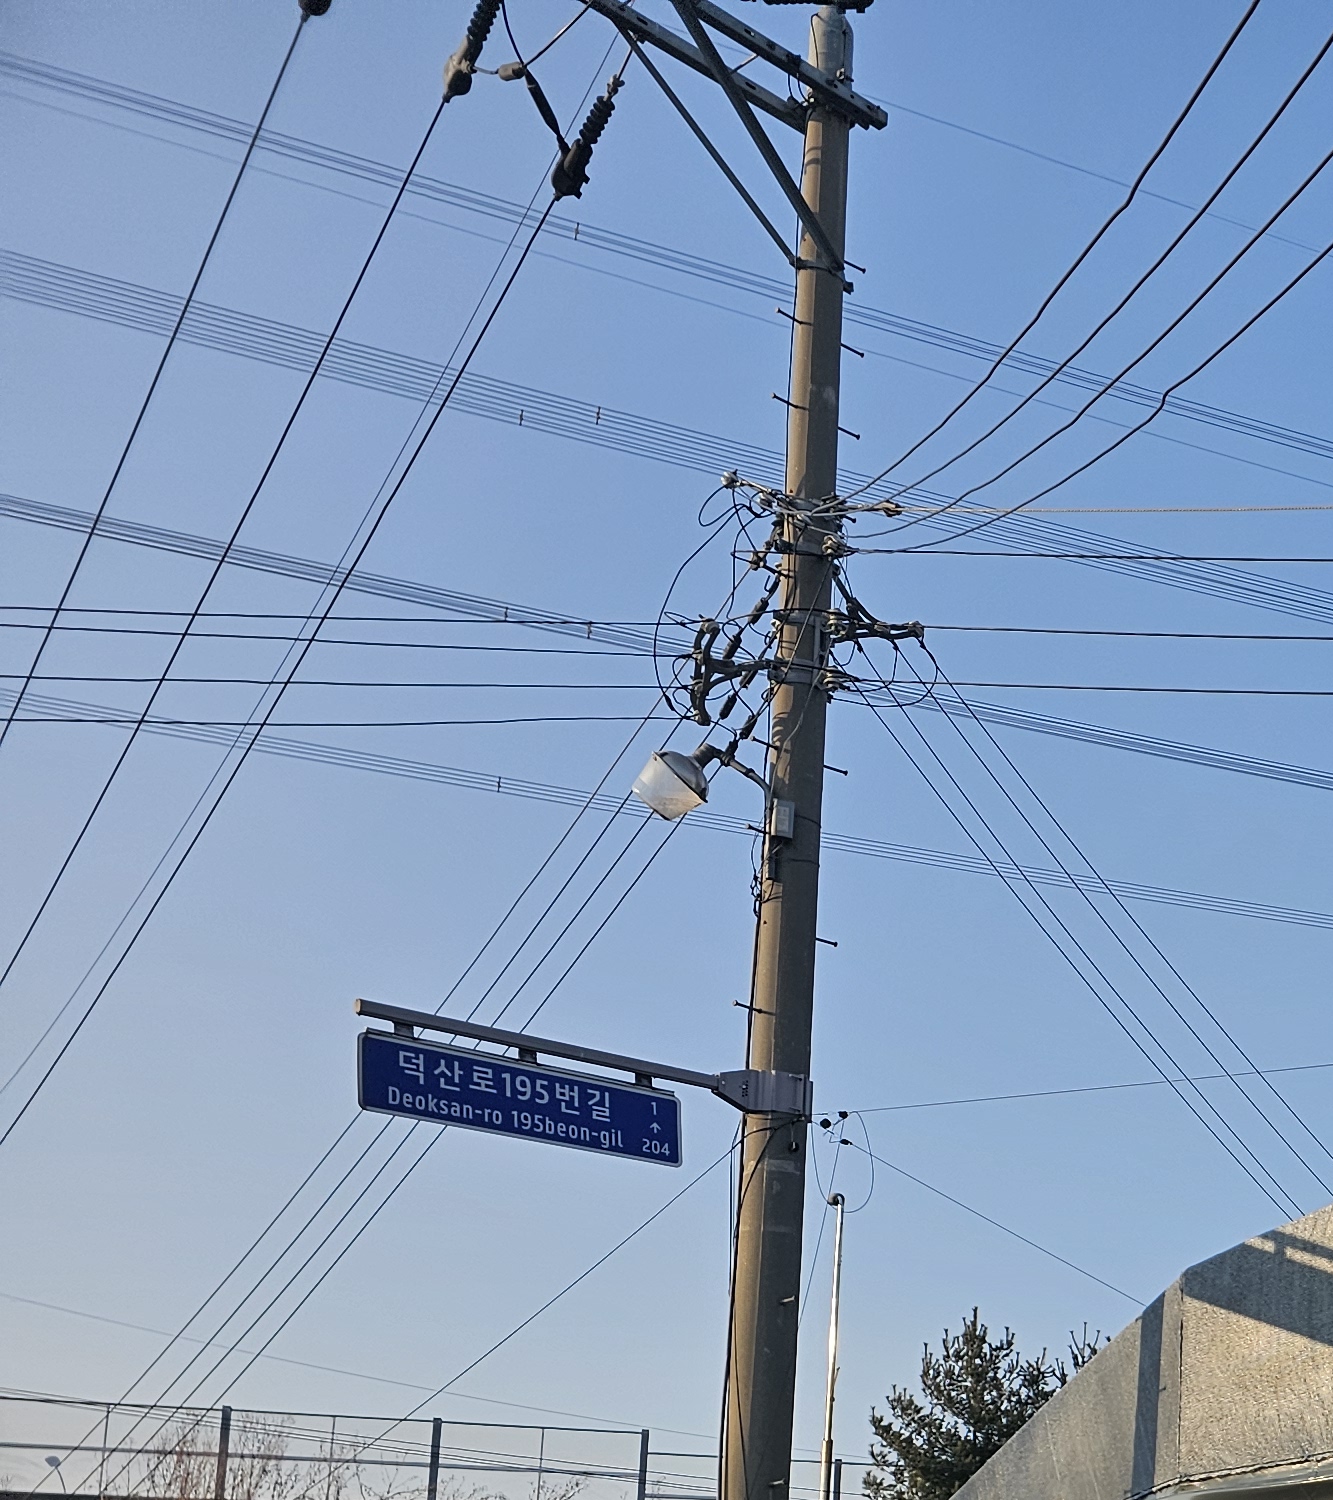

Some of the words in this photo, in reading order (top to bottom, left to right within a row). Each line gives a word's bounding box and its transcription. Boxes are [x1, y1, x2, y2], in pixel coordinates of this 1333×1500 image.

[398, 1050, 611, 1122] 덕산로195번길
[388, 1086, 502, 1125] Deoksan-ro
[511, 1110, 624, 1148] 195beon-gil
[651, 1101, 658, 1116] 1
[642, 1138, 671, 1156] 204
